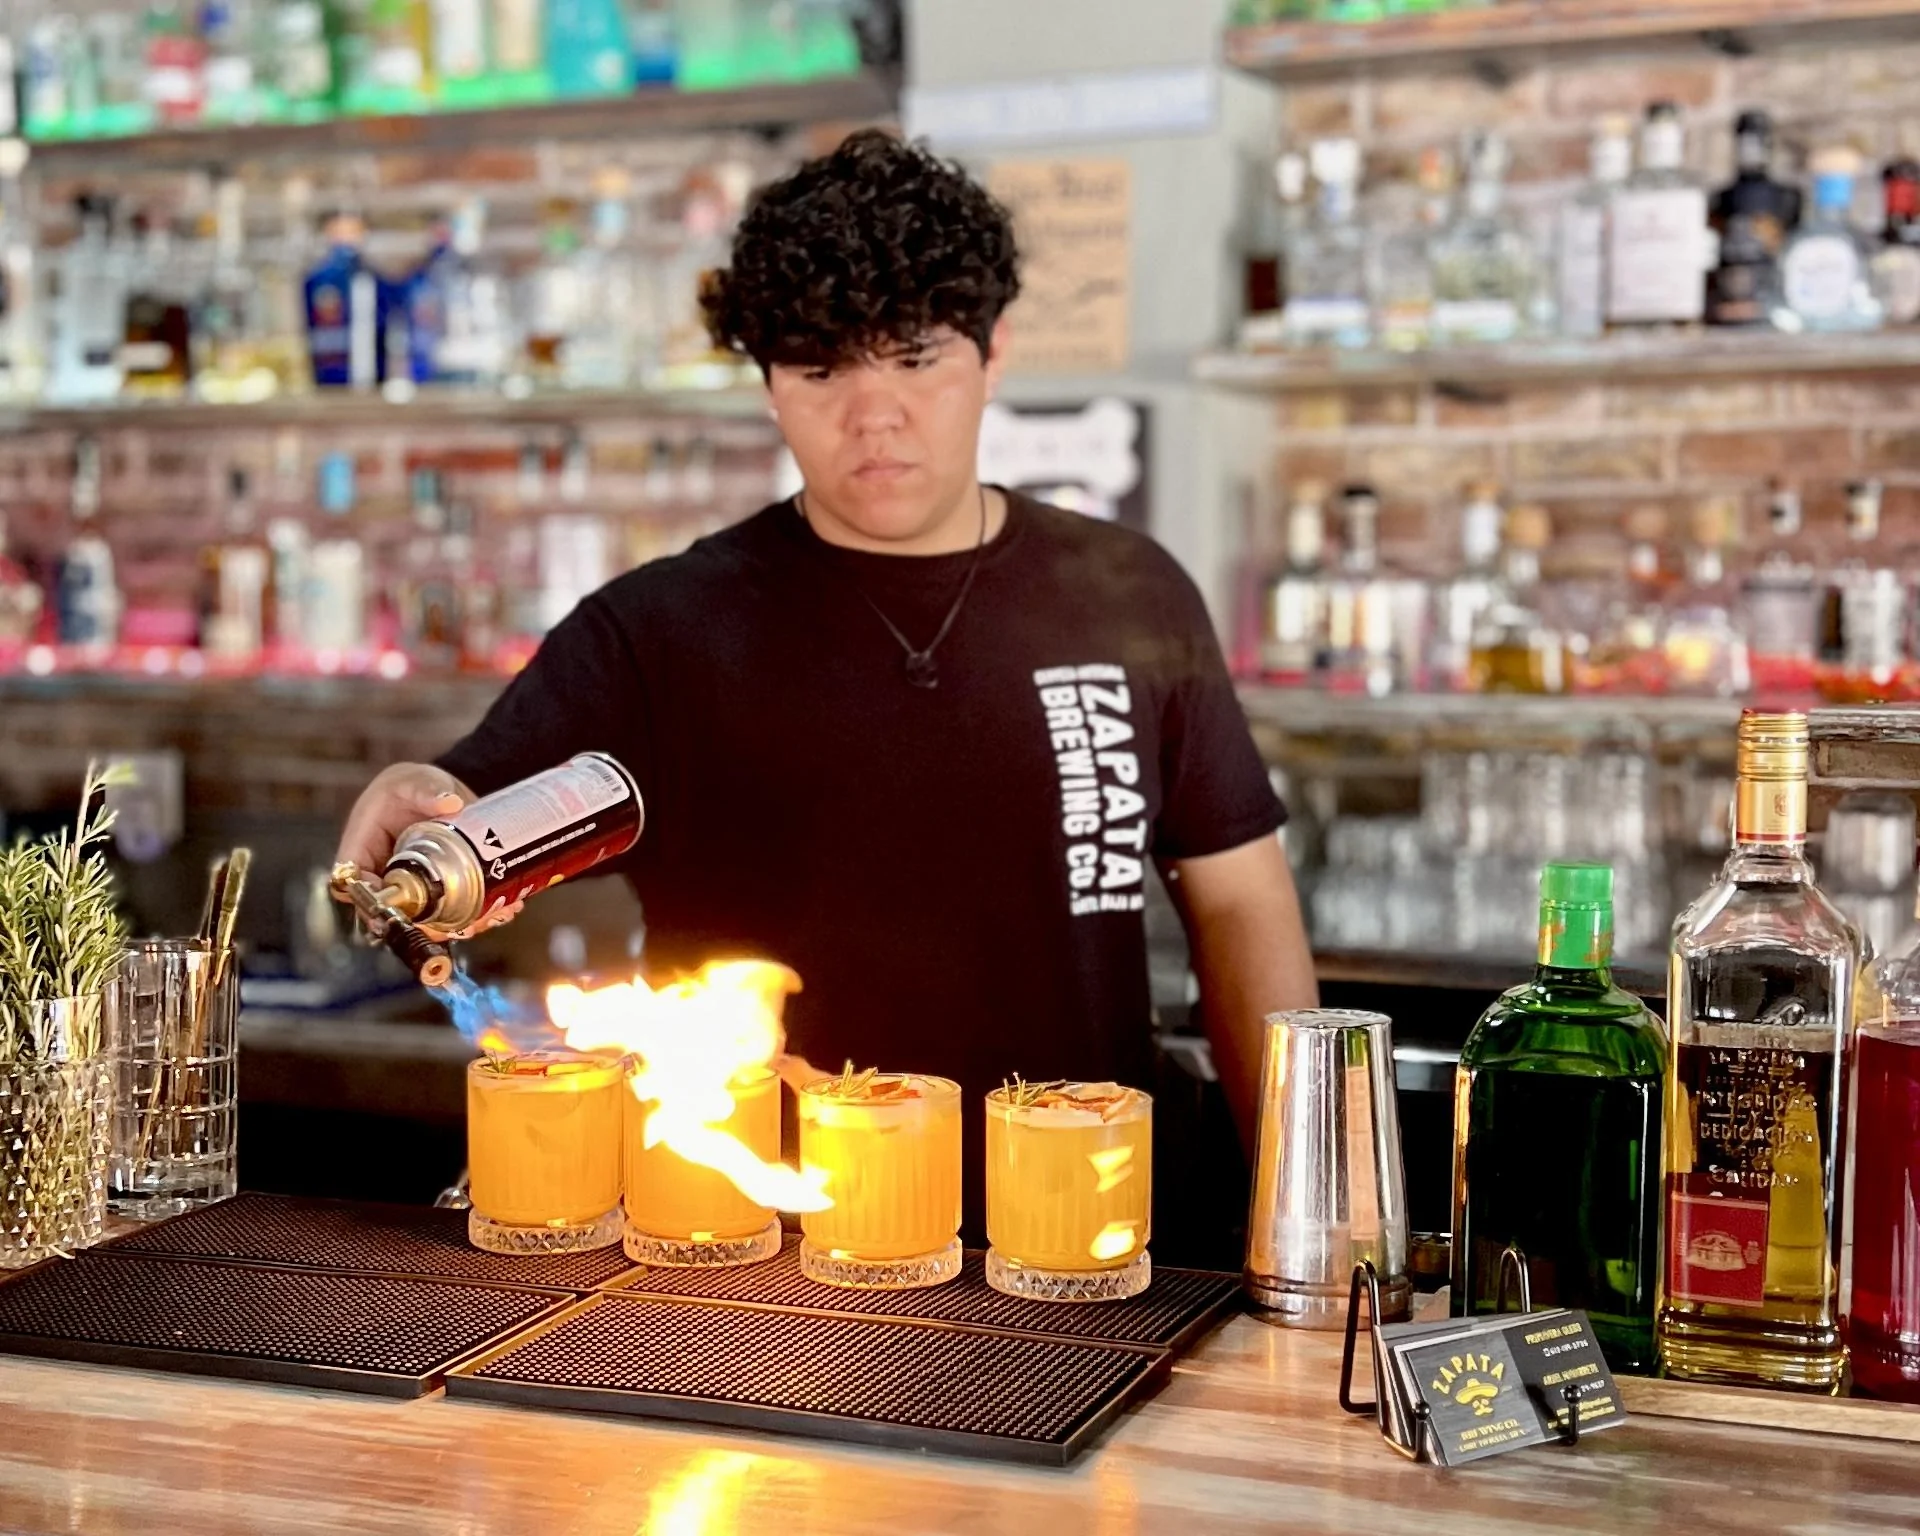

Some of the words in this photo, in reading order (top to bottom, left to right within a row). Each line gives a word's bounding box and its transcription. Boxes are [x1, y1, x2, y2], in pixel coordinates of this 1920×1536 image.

[1039, 685, 1101, 836] BREWING
[1078, 683, 1147, 889] ZAPATA
[1432, 1353, 1504, 1395] ZAPATA
